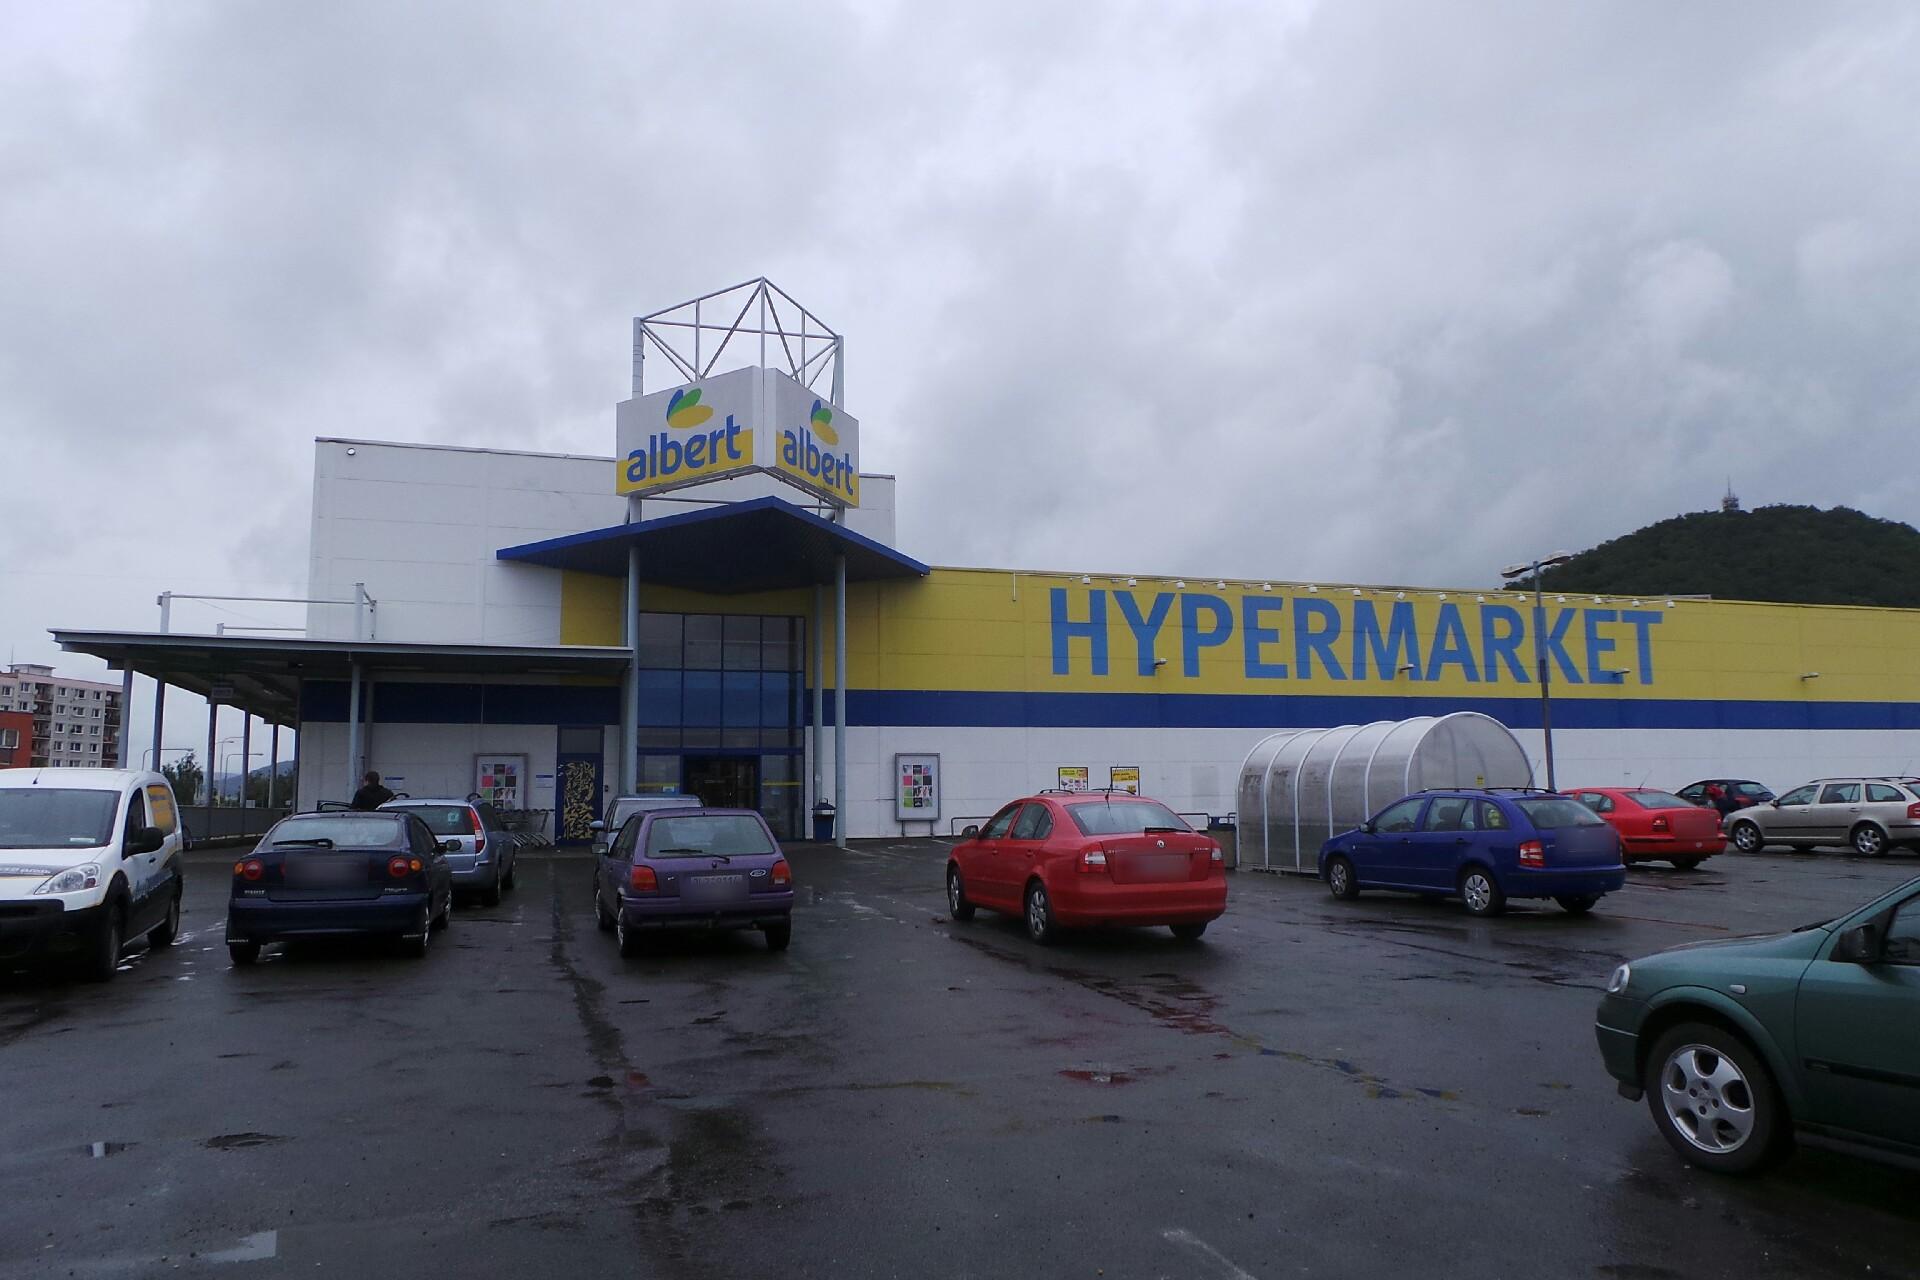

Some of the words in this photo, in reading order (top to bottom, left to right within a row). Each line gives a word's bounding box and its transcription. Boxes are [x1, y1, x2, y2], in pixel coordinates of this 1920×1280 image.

[626, 414, 742, 483] albert
[783, 425, 853, 496] albert
[1049, 587, 1664, 685] HYPERMARKET
